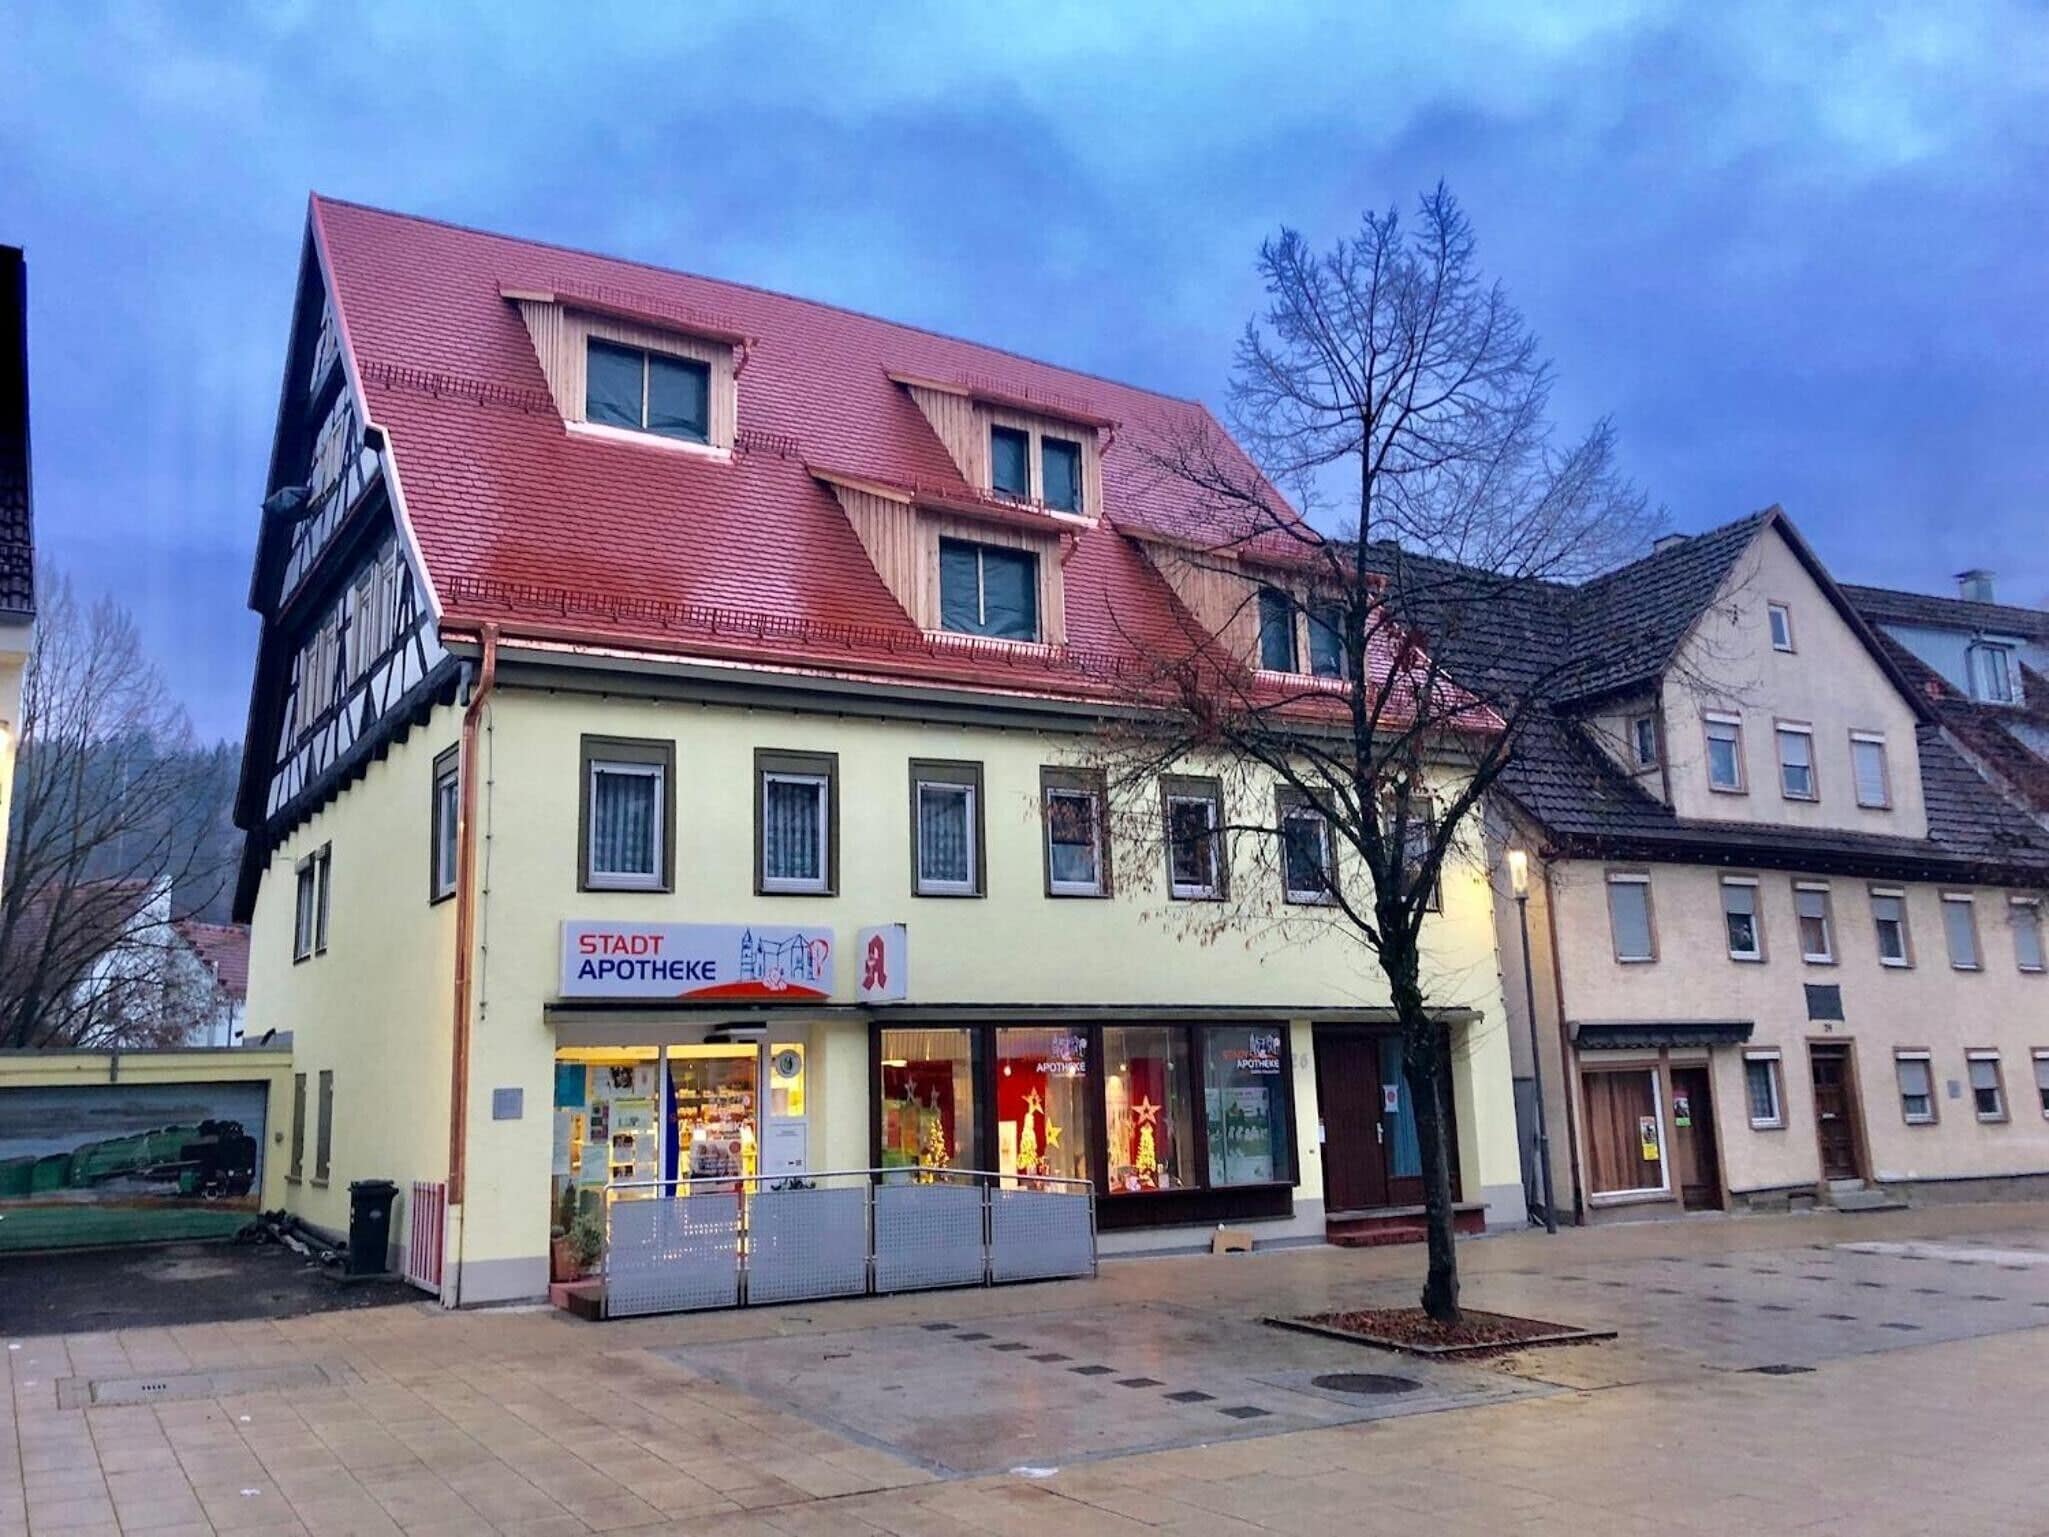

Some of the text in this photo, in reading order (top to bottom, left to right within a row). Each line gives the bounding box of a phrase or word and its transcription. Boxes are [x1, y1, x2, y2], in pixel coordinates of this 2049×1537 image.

[579, 934, 664, 955] STADT
[578, 959, 716, 980] APOTHEKE
[1237, 1059, 1280, 1068] APOTHEKE
